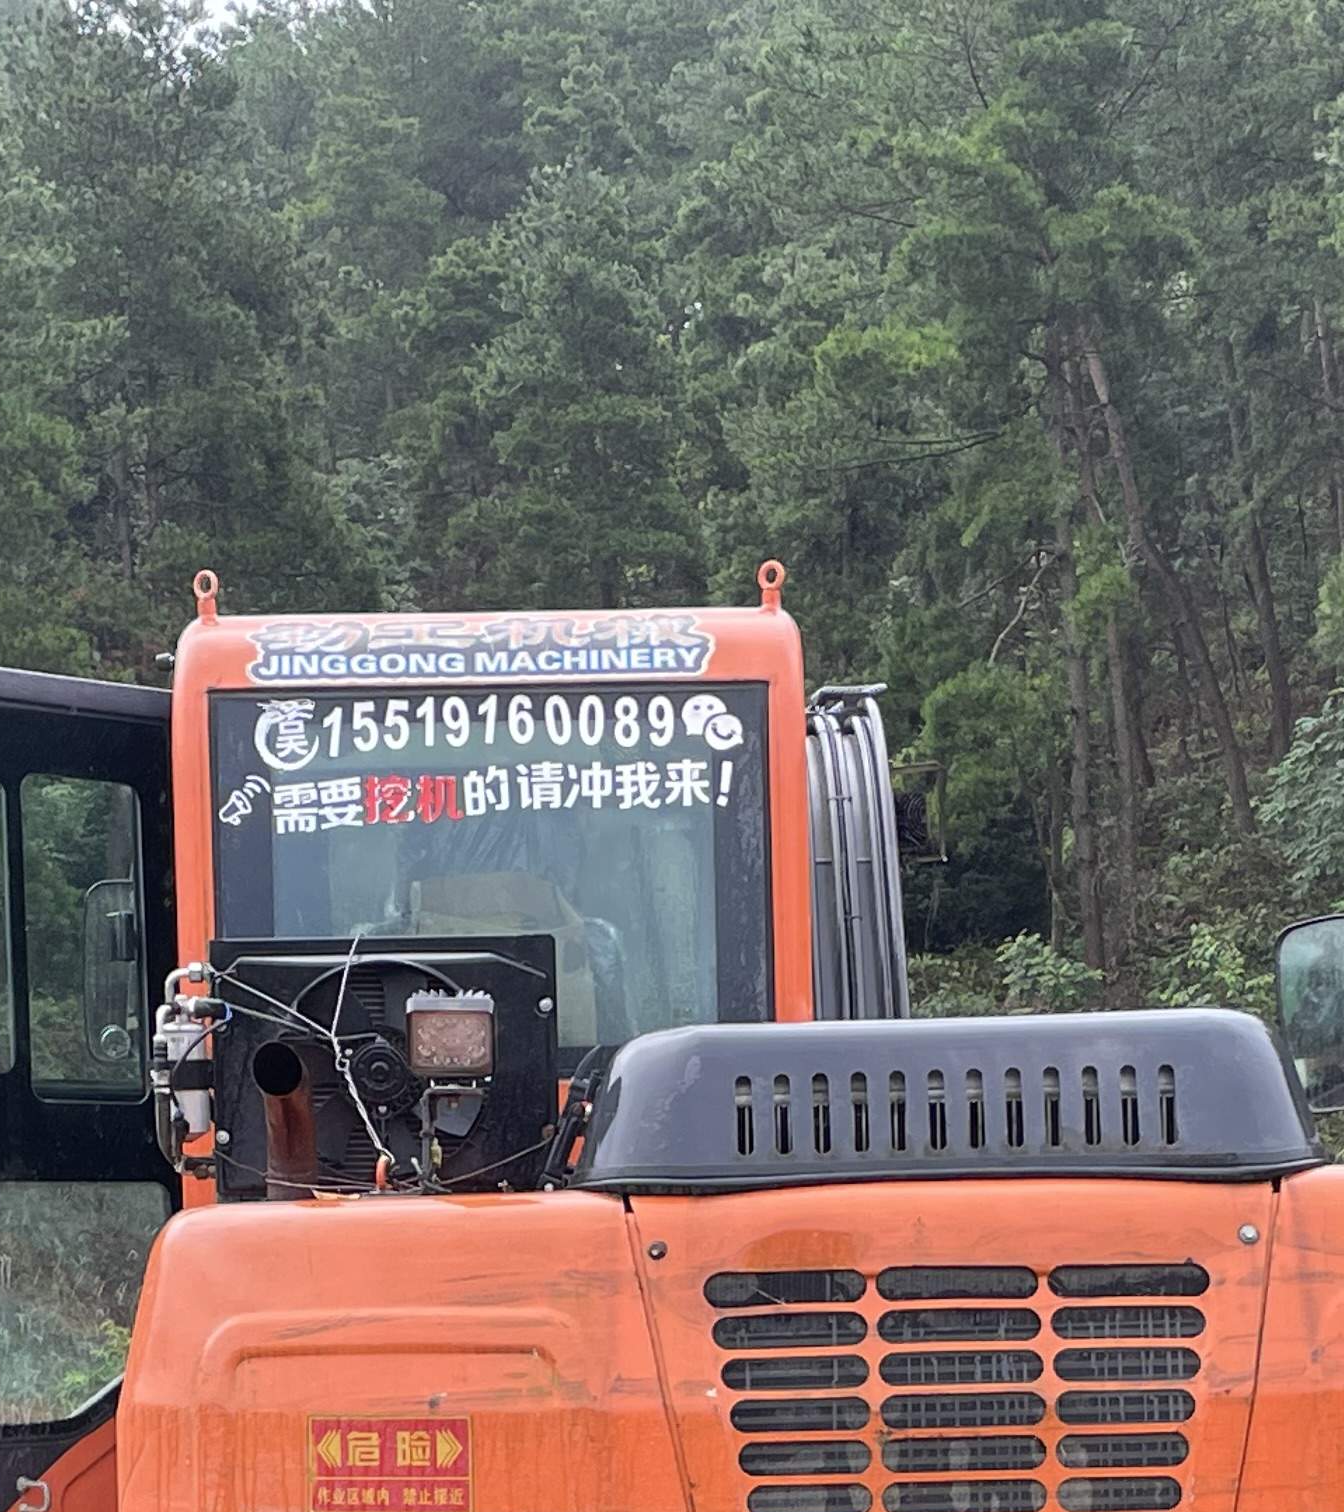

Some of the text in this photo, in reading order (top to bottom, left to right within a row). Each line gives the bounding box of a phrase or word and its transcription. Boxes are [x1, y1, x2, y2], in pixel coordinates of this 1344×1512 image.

[259, 647, 702, 675] JINGGONG MACHINERY
[322, 694, 675, 758] 15519160089
